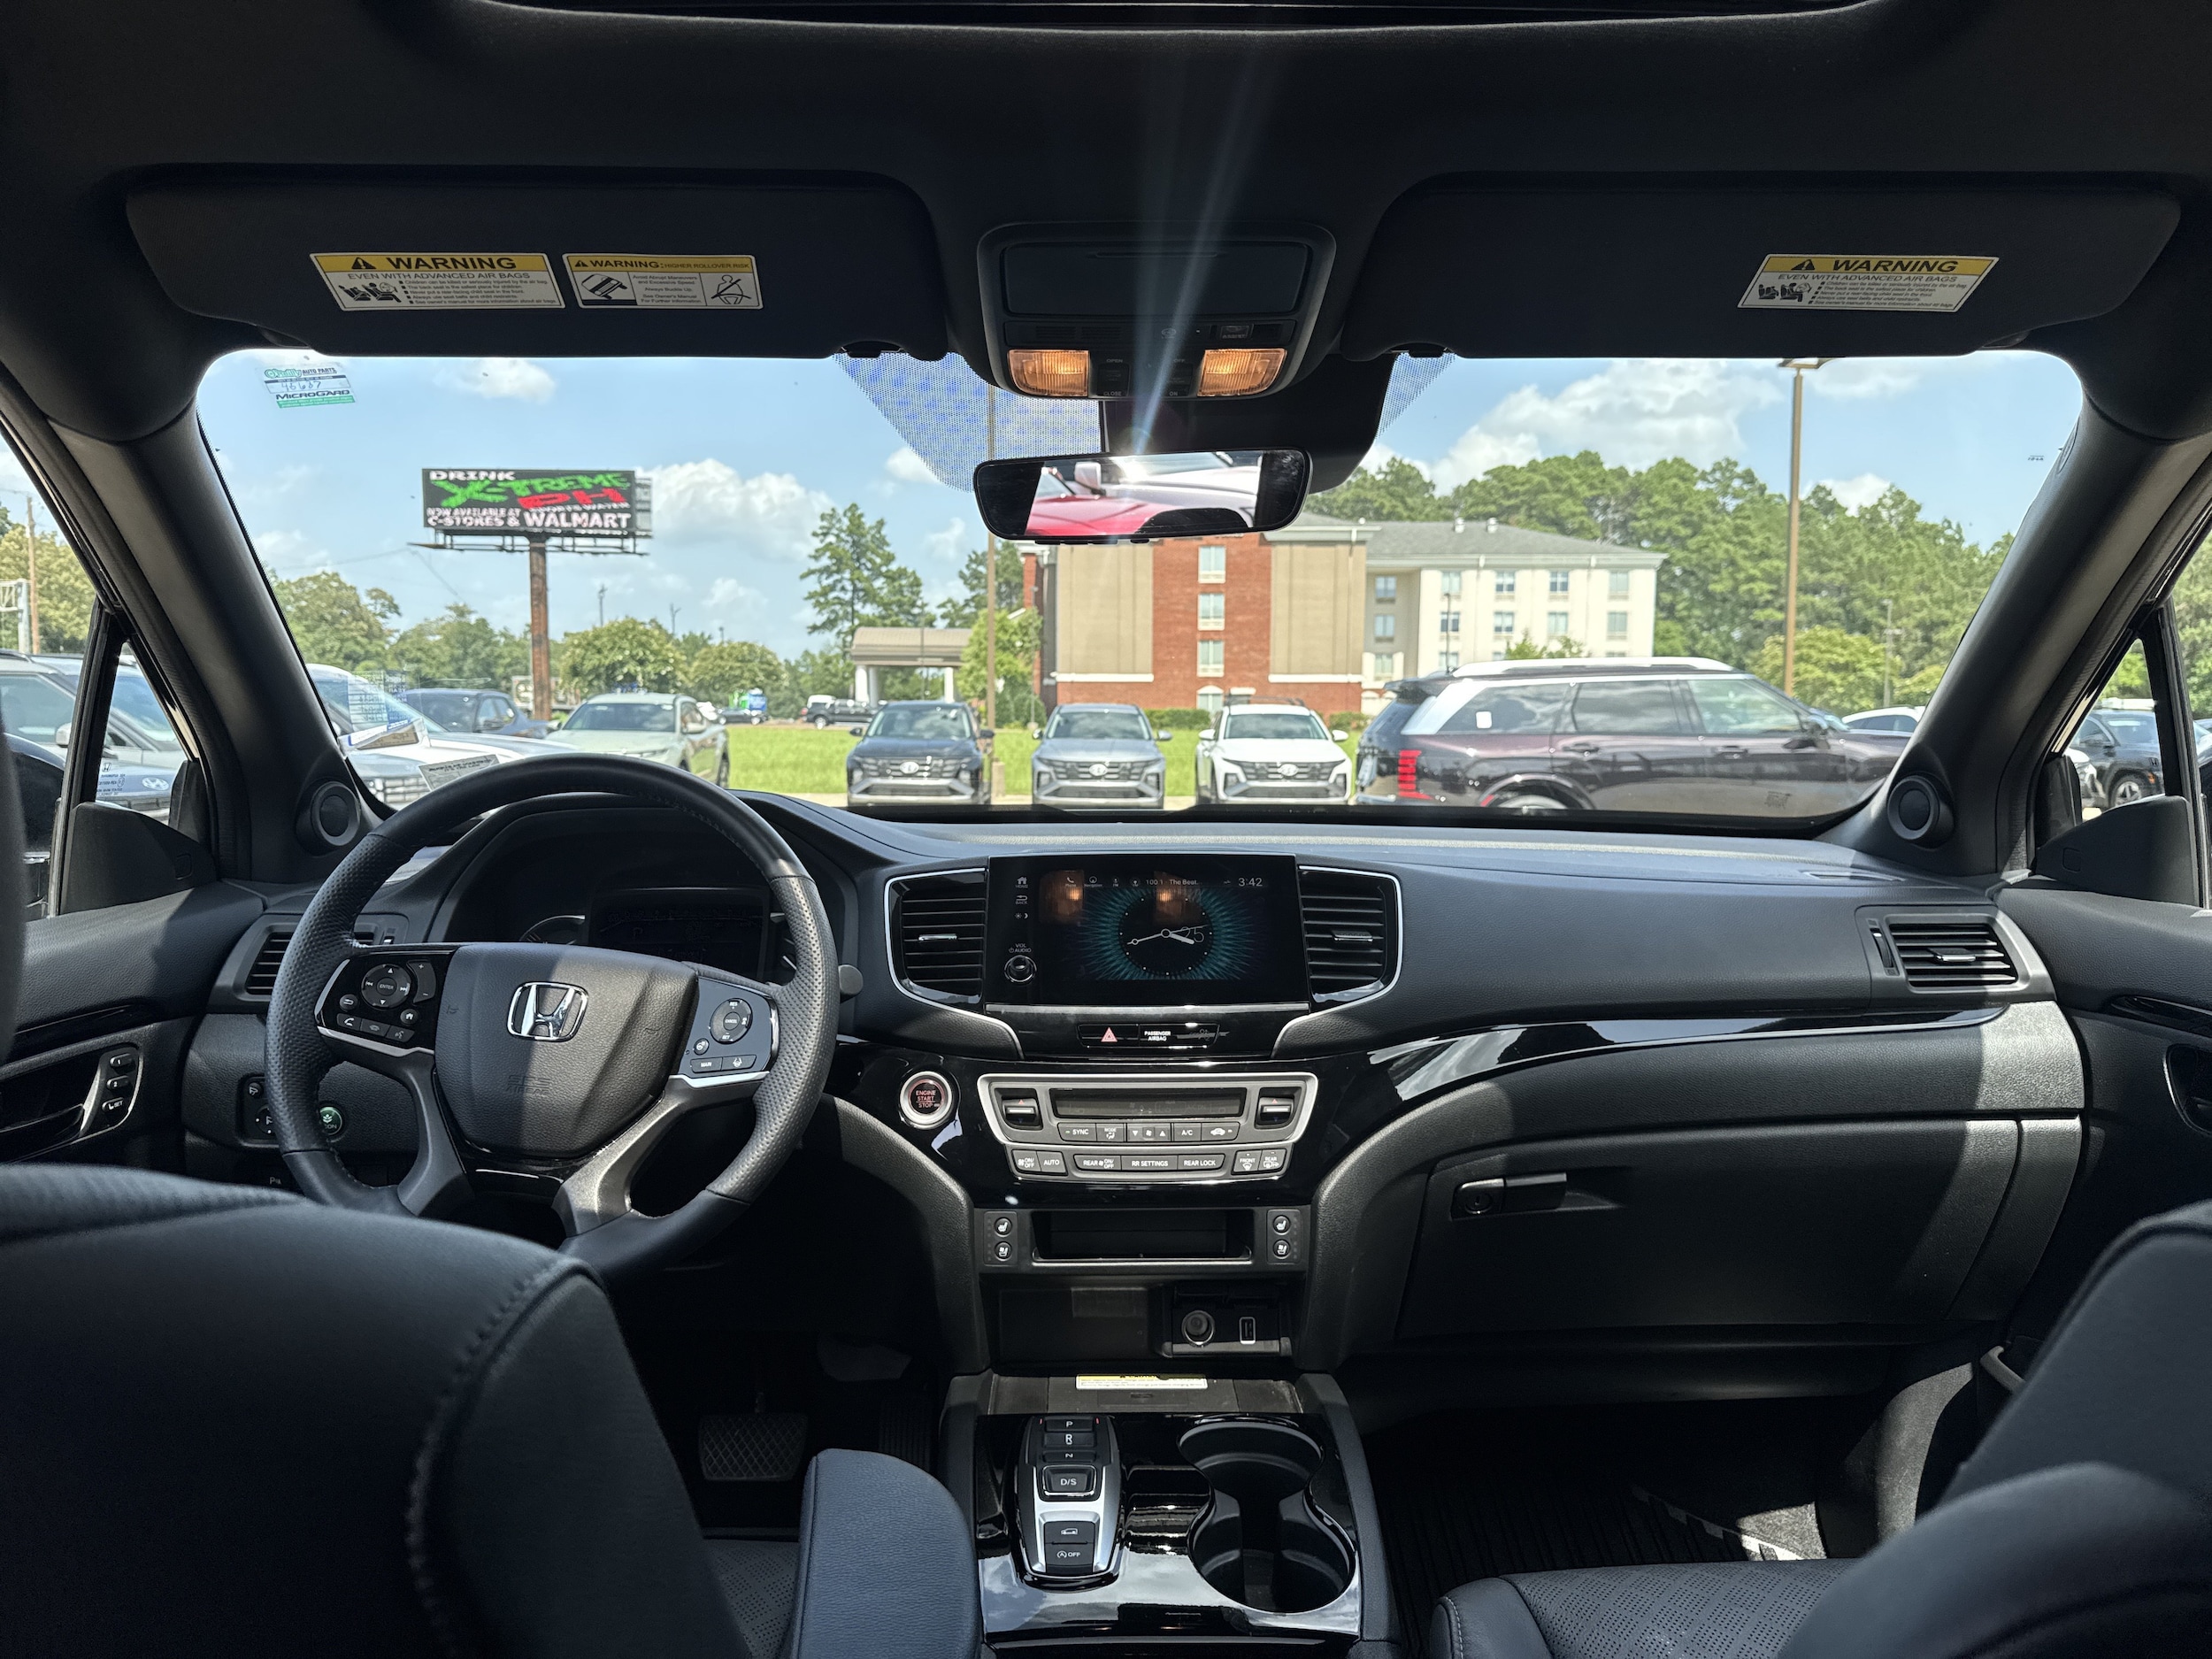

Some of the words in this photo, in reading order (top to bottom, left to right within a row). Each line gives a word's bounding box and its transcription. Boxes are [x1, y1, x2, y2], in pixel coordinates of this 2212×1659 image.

[386, 257, 517, 269] WARNING
[1832, 259, 1959, 273] WARNING
[429, 471, 517, 480] DRINK
[426, 507, 453, 517] NOW
[454, 507, 506, 517] AVAILABLE
[507, 508, 522, 518] AT
[426, 517, 504, 526] C-STORES
[506, 517, 520, 526] &
[523, 511, 632, 528] WALMART
[1238, 877, 1263, 887] 3:42
[1065, 1433, 1072, 1444] R
